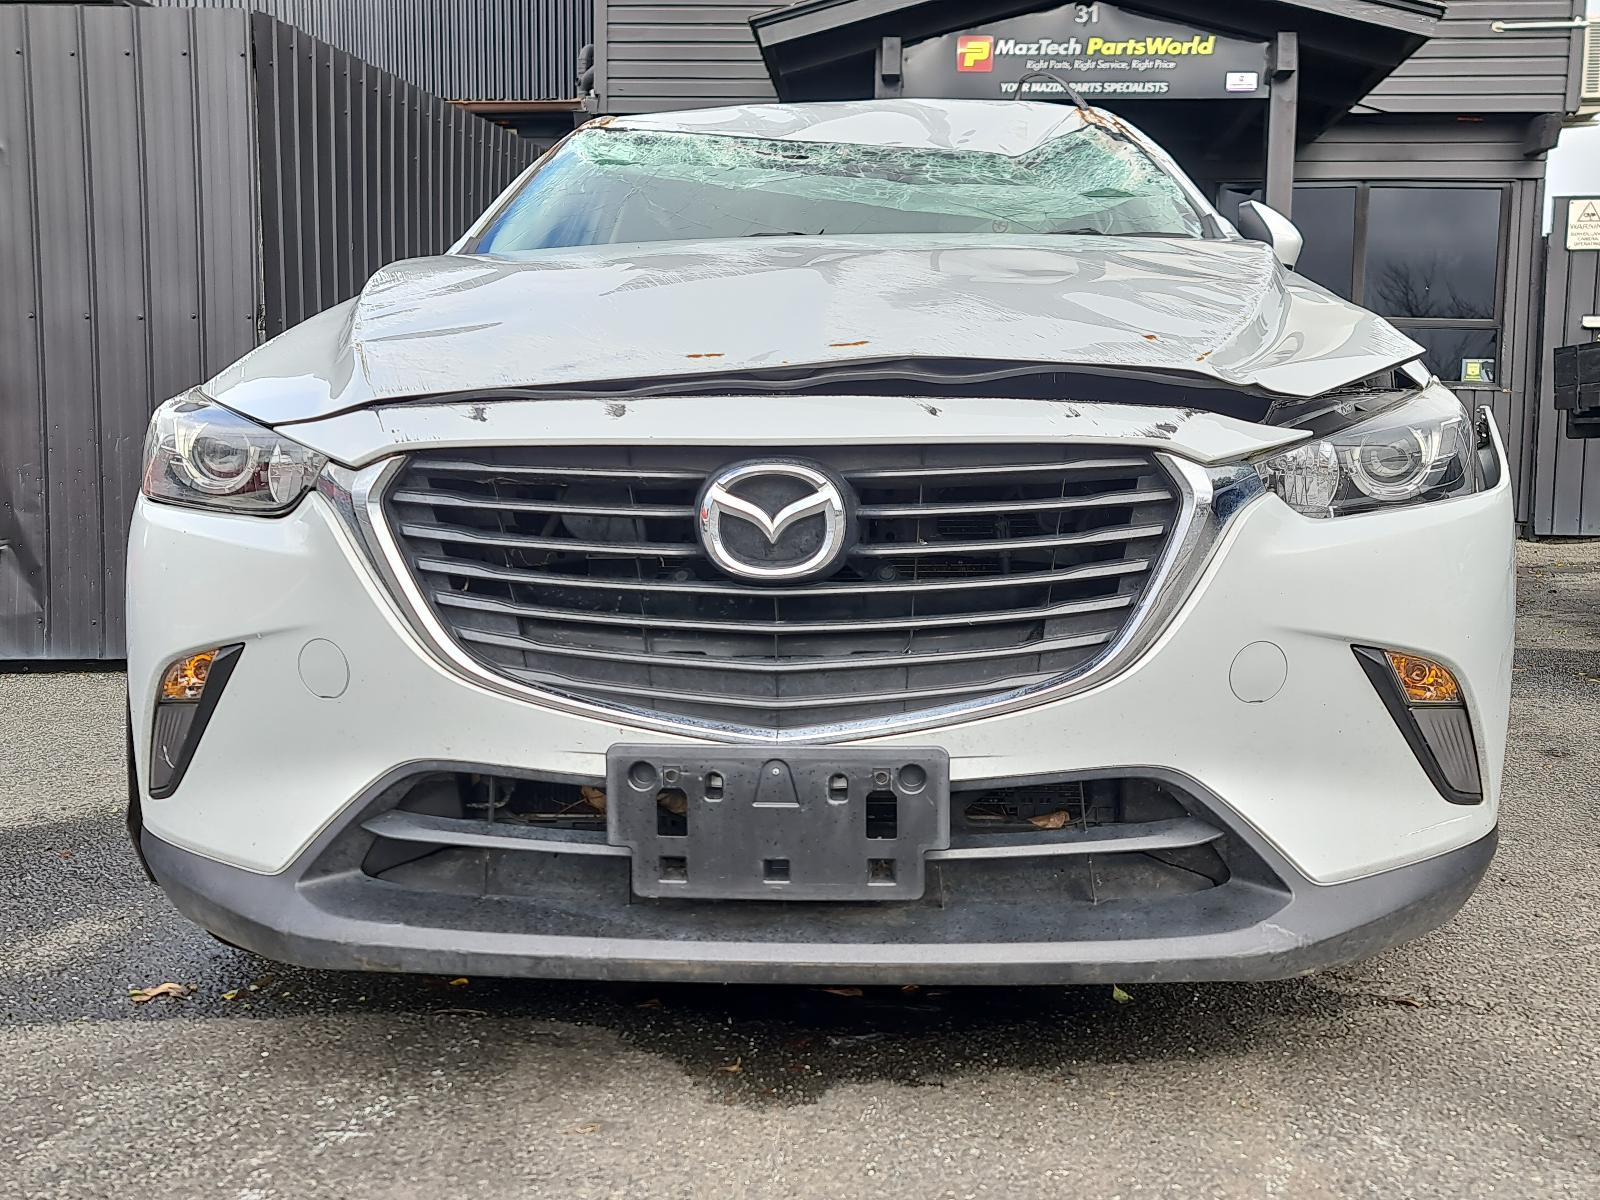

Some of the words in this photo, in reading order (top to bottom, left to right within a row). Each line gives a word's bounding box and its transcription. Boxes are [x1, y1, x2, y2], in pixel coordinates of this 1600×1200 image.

[1074, 3, 1099, 23] 31
[995, 37, 1082, 55] MazTech
[1087, 36, 1216, 55] PartsWorld
[1026, 59, 1048, 71] Right
[1049, 60, 1072, 70] Parts,
[1074, 59, 1096, 71] Right
[1097, 59, 1130, 70] Service,
[1132, 59, 1154, 71] Right
[1155, 59, 1176, 69] Price
[1103, 82, 1169, 93] SPECIALISTS
